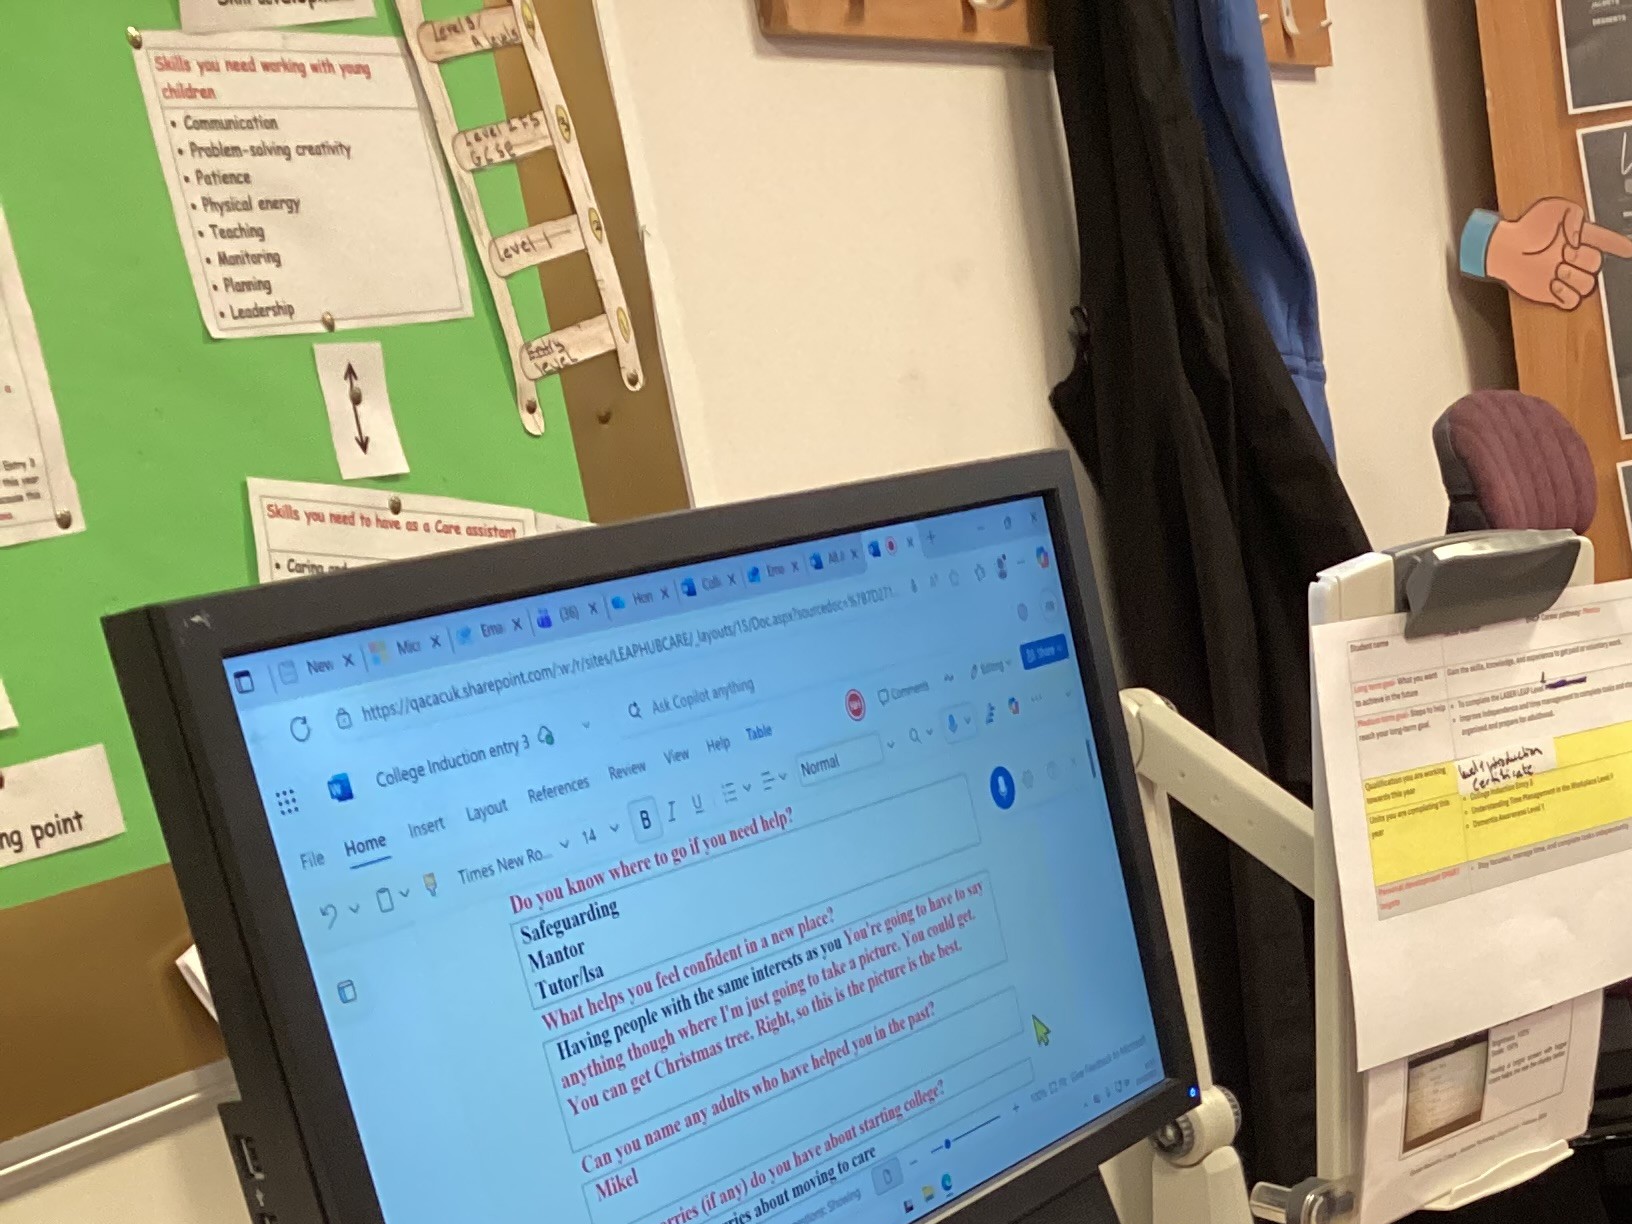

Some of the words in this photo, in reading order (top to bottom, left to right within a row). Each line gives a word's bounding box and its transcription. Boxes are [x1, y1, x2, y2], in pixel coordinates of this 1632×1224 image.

[154, 56, 191, 73] Skills
[197, 58, 220, 77] you
[225, 58, 256, 73] need
[260, 59, 307, 78] working
[311, 59, 335, 75] with
[339, 63, 371, 80] young
[162, 82, 216, 100] children
[184, 114, 278, 131] Communication
[189, 141, 292, 161] Problem-solving
[295, 142, 351, 160] creativity
[195, 170, 250, 186] Patience
[201, 195, 252, 219] Physical
[258, 198, 300, 214] energy
[208, 223, 265, 242] Teaching
[218, 250, 282, 268] Monitoring
[223, 276, 272, 295] Planning
[229, 301, 295, 320] Leadership
[266, 503, 300, 521] Skills
[304, 510, 326, 525] you
[329, 512, 356, 527] need
[360, 514, 371, 527] to
[375, 514, 401, 530] have
[406, 520, 418, 532] as
[423, 523, 431, 533] a
[435, 519, 462, 535] Care
[465, 525, 517, 539] assistant
[376, 764, 426, 788] College
[427, 748, 487, 775] Induction
[489, 738, 521, 759] entry
[523, 734, 530, 750] 3
[801, 752, 840, 777] Normal
[300, 852, 326, 871] File
[343, 835, 387, 857] Home
[408, 816, 446, 838] Insert
[465, 799, 509, 823] Layout
[527, 776, 591, 803] References
[608, 760, 647, 780] Review
[663, 748, 689, 765] View
[705, 736, 731, 754] Help
[745, 723, 773, 742] Table
[31, 810, 83, 849] point
[457, 865, 495, 885] Times
[496, 854, 524, 873] New
[509, 894, 532, 914] Do
[536, 887, 564, 910] you
[565, 872, 605, 896] know
[608, 856, 651, 881] where
[654, 849, 669, 867] to
[671, 846, 687, 865] go
[689, 837, 701, 854] if
[702, 832, 727, 856] you
[730, 818, 759, 843] need
[760, 805, 793, 832] help?
[520, 899, 620, 945] Safeguarding
[527, 940, 585, 972] Mantor
[541, 1004, 584, 1031] What
[588, 989, 626, 1016] helps
[627, 981, 654, 1005] you
[655, 964, 680, 989] feel
[682, 945, 742, 979] confident
[745, 938, 758, 955] in
[760, 937, 769, 950] a
[771, 923, 796, 946] new
[798, 906, 835, 936] place?
[581, 1151, 613, 1175] Can
[614, 1138, 643, 1166] you
[643, 1120, 682, 1147] name
[683, 1107, 708, 1135] any
[711, 1087, 751, 1118] adults
[752, 1074, 779, 1098] who
[780, 1061, 809, 1085] have
[810, 1040, 850, 1071] helped
[851, 1028, 874, 1054] you
[874, 1024, 887, 1041] in
[888, 1014, 906, 1033] the
[907, 1001, 935, 1029] past?
[595, 1166, 640, 1202] Mikel
[753, 1188, 790, 1219] about
[791, 1164, 837, 1199] moving
[836, 1157, 851, 1175] to
[850, 1145, 878, 1170] care
